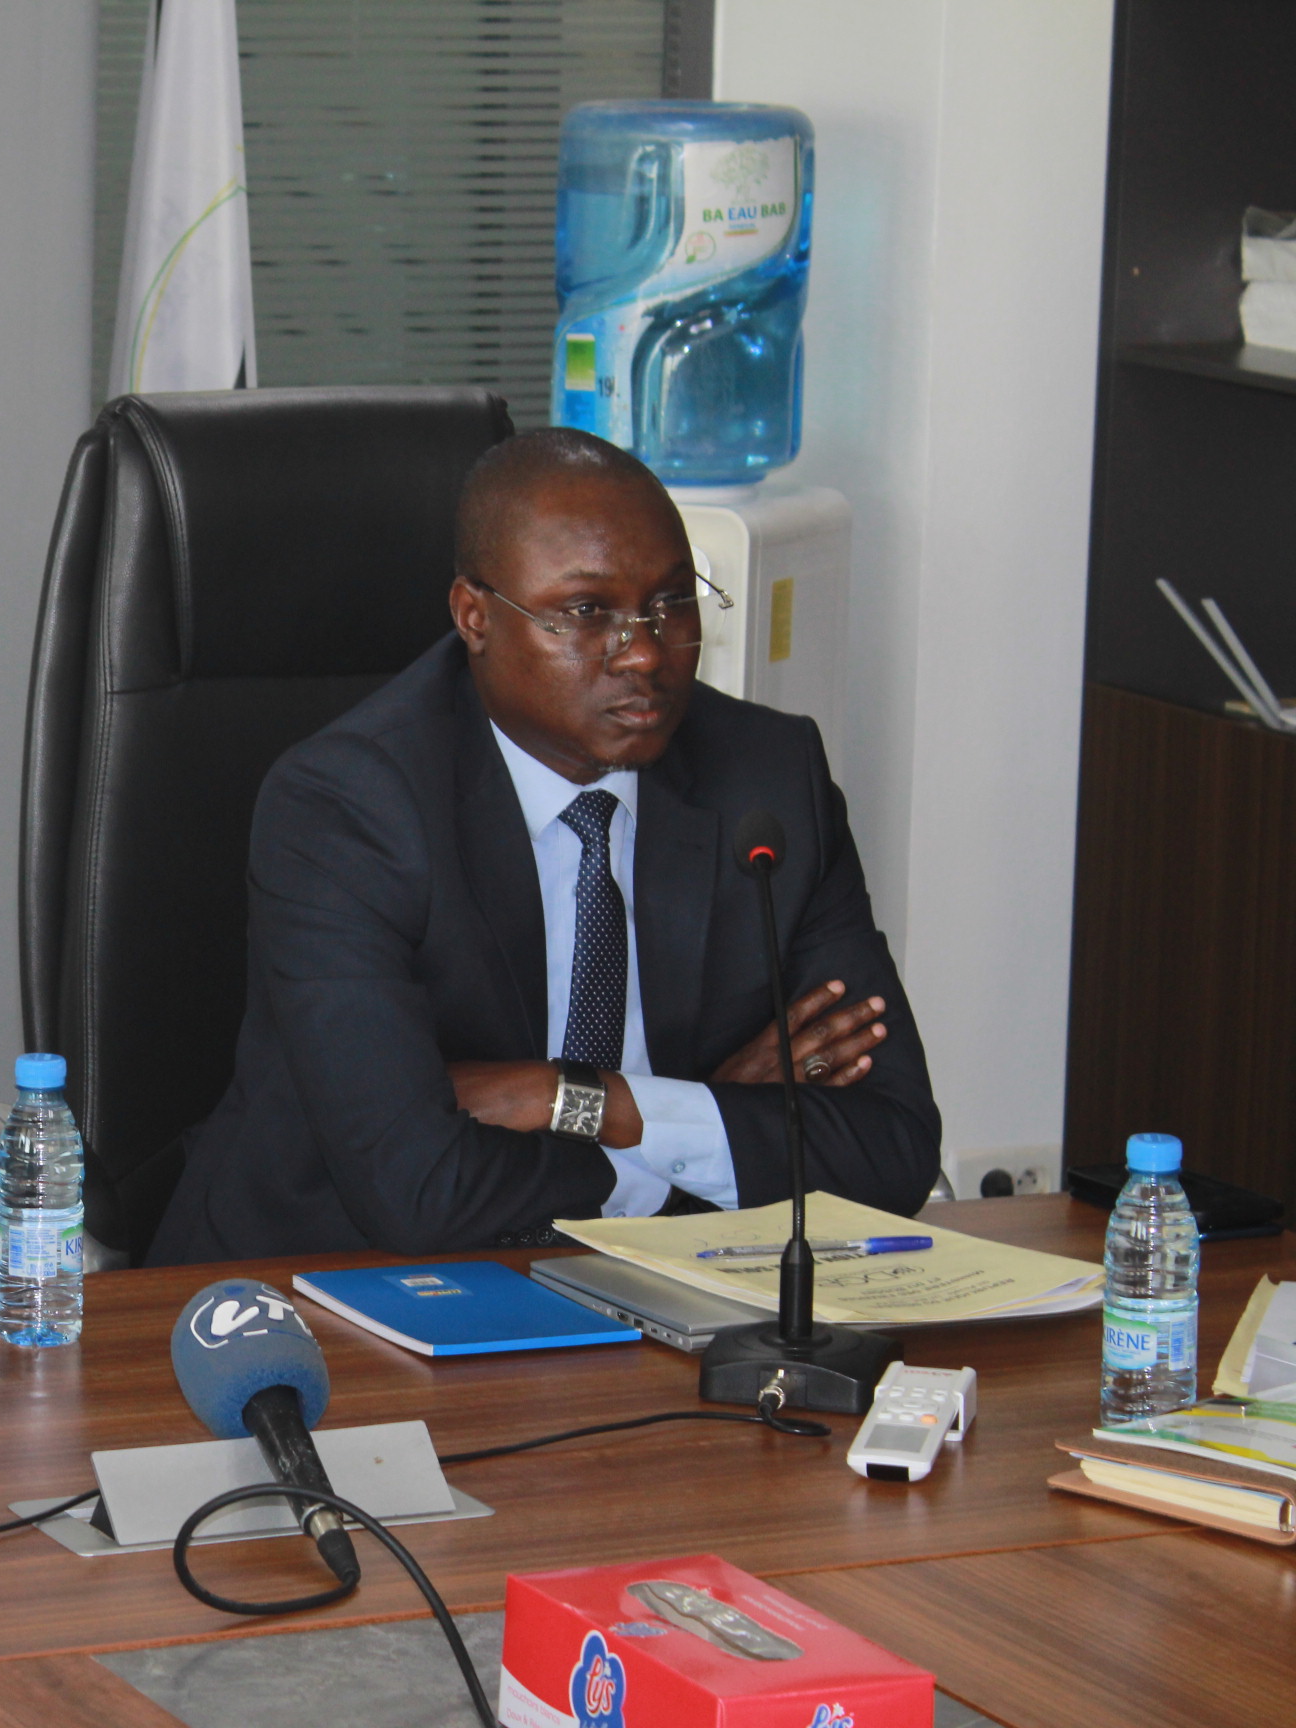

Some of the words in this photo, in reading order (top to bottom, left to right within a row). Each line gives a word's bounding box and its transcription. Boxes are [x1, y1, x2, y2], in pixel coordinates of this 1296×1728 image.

[702, 208, 724, 222] BA
[728, 206, 757, 221] EAU
[65, 1236, 83, 1256] KIR
